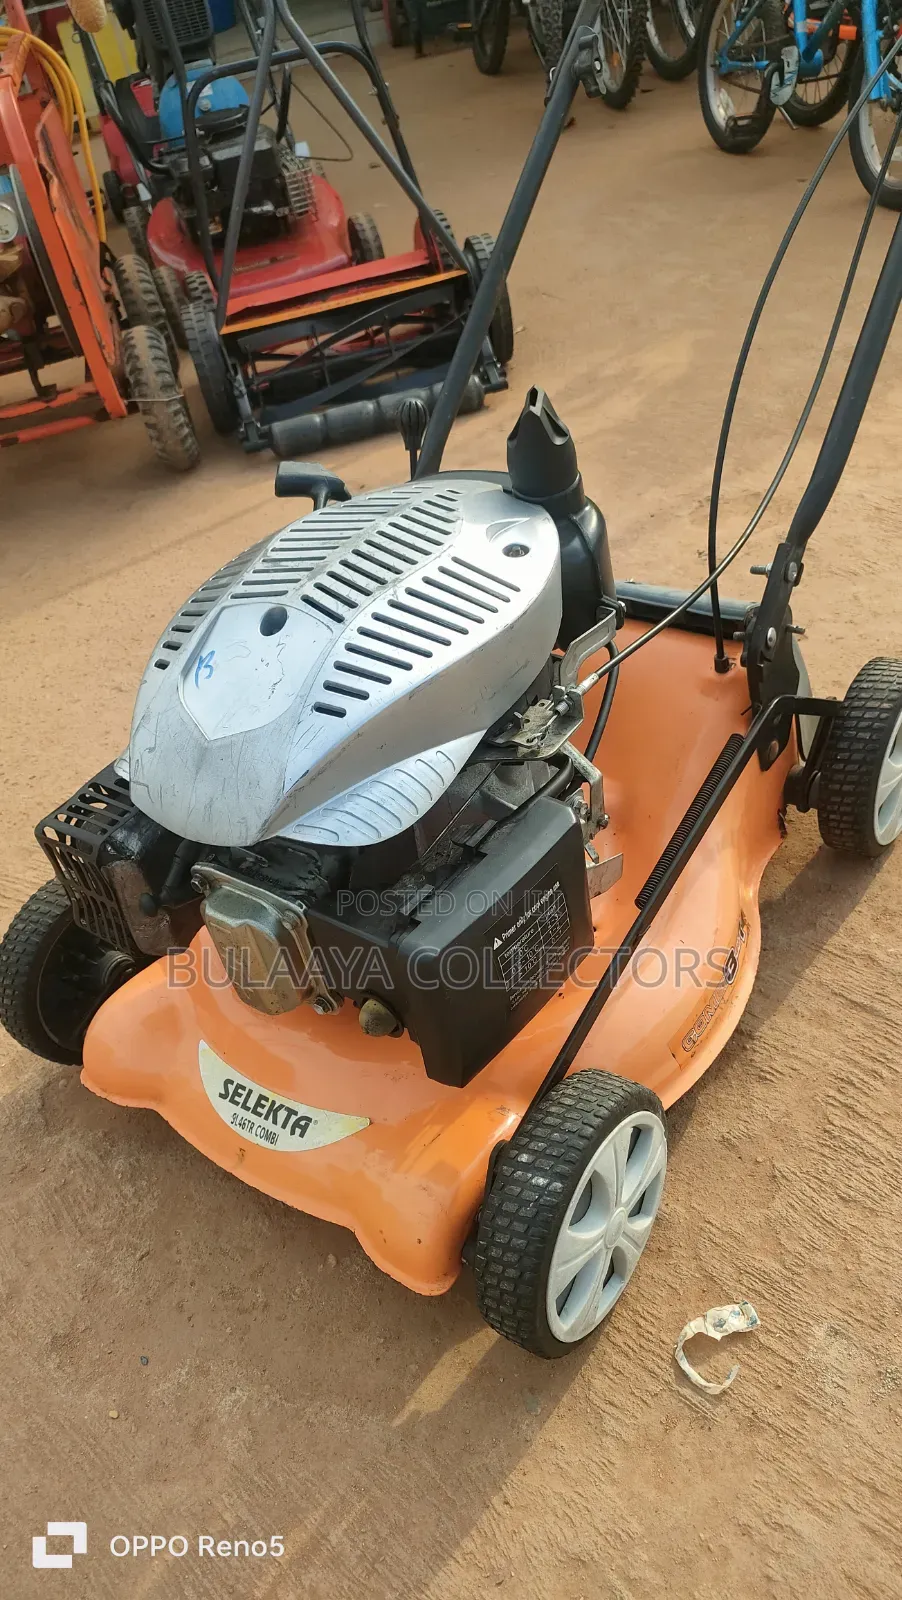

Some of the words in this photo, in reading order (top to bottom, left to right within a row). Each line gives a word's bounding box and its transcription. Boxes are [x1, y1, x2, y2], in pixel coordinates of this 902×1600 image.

[502, 924, 516, 941] Primer
[517, 915, 526, 929] only
[531, 900, 540, 913] cool
[218, 1078, 313, 1139] SELEKTA
[254, 1124, 279, 1146] COMBI
